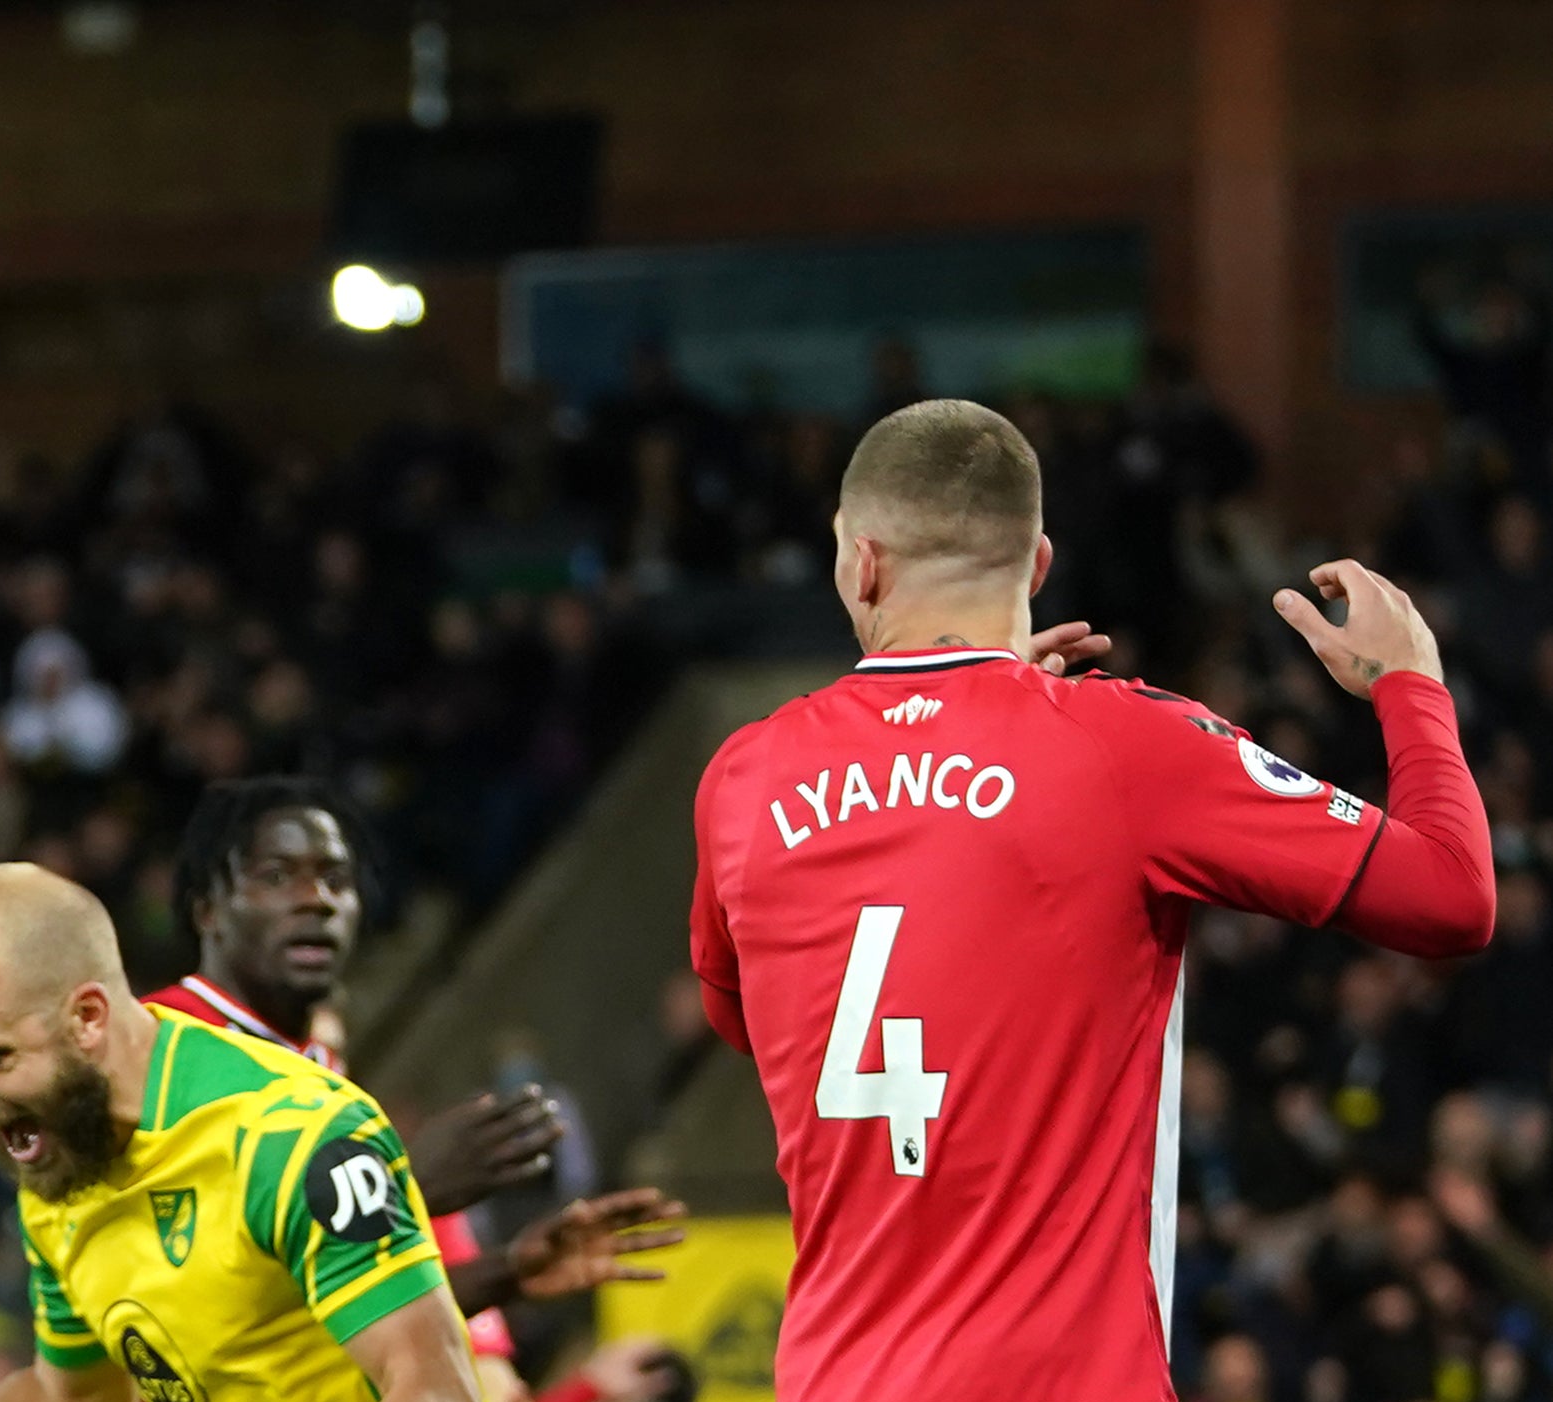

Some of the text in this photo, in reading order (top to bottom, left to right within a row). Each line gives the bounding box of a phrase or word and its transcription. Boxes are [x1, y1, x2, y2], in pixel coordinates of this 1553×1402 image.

[768, 752, 1016, 851] LYANCO
[815, 904, 949, 1178] 4
[329, 1153, 388, 1233] JD
